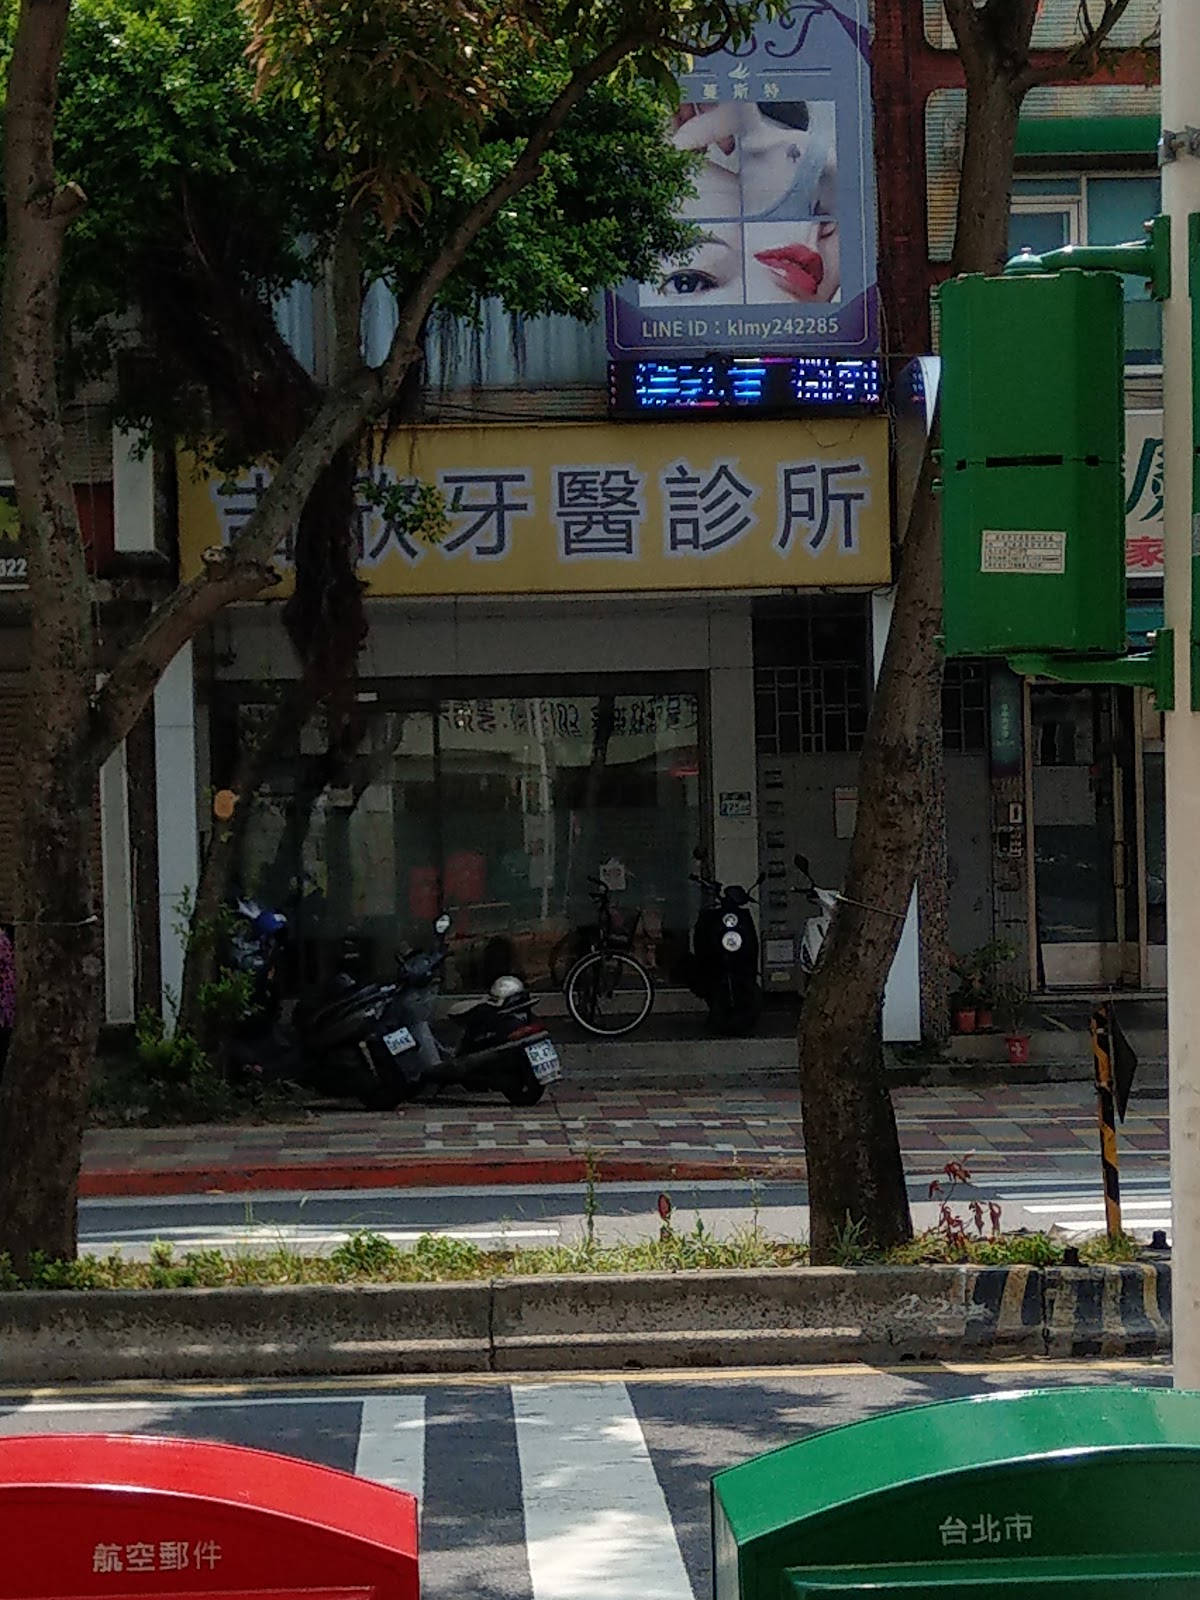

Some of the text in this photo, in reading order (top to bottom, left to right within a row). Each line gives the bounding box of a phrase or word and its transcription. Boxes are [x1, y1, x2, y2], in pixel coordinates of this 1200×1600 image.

[642, 321, 682, 338] LINE
[938, 1513, 1033, 1546] 台北市
[92, 1540, 222, 1573] 航空郵件
